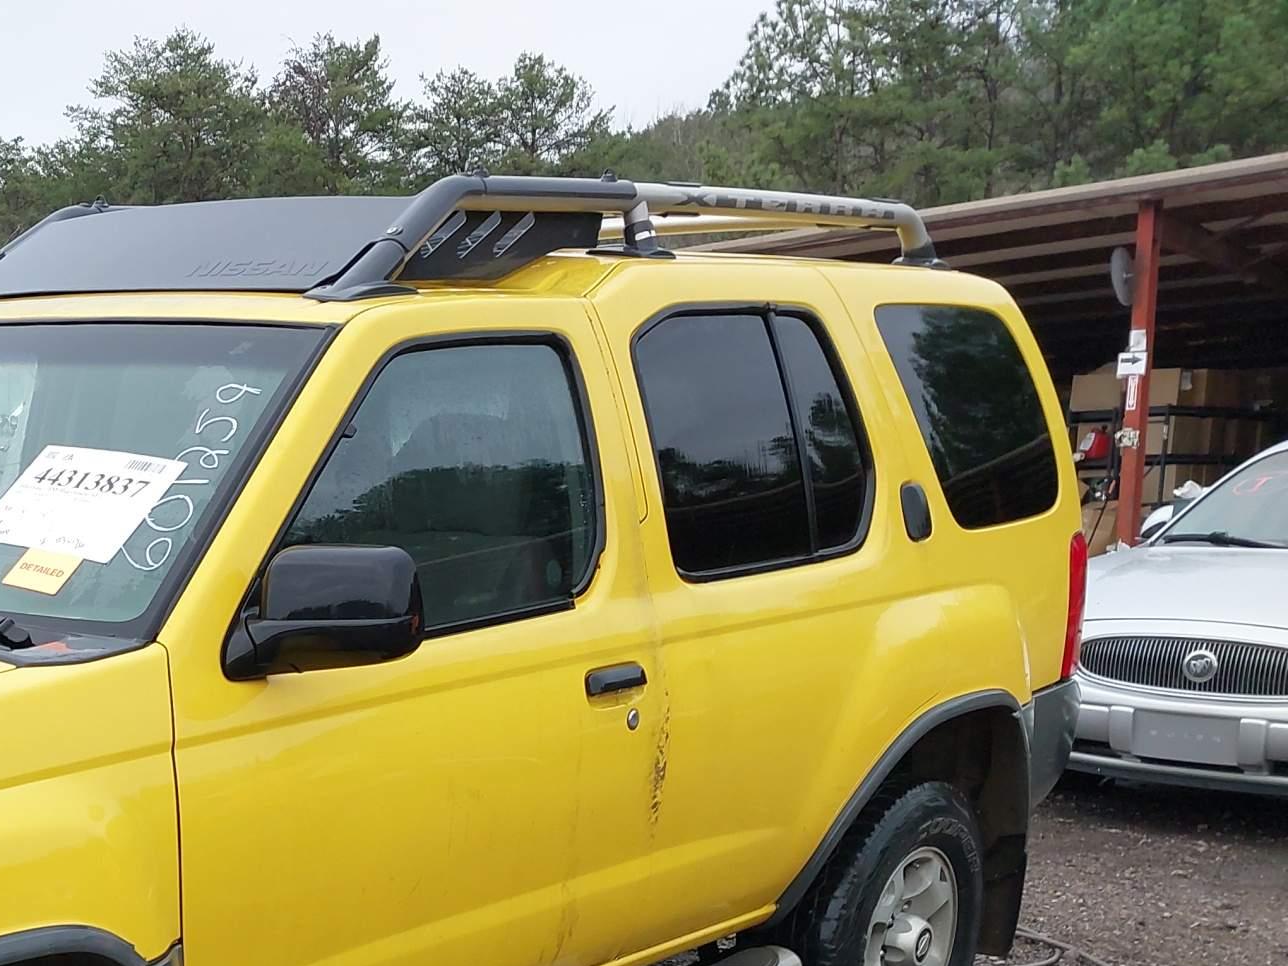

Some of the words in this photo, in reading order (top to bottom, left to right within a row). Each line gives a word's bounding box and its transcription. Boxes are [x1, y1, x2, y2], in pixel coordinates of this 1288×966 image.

[184, 257, 330, 279] NISSAN
[33, 467, 151, 498] 44313837
[18, 560, 65, 579] DETAILED
